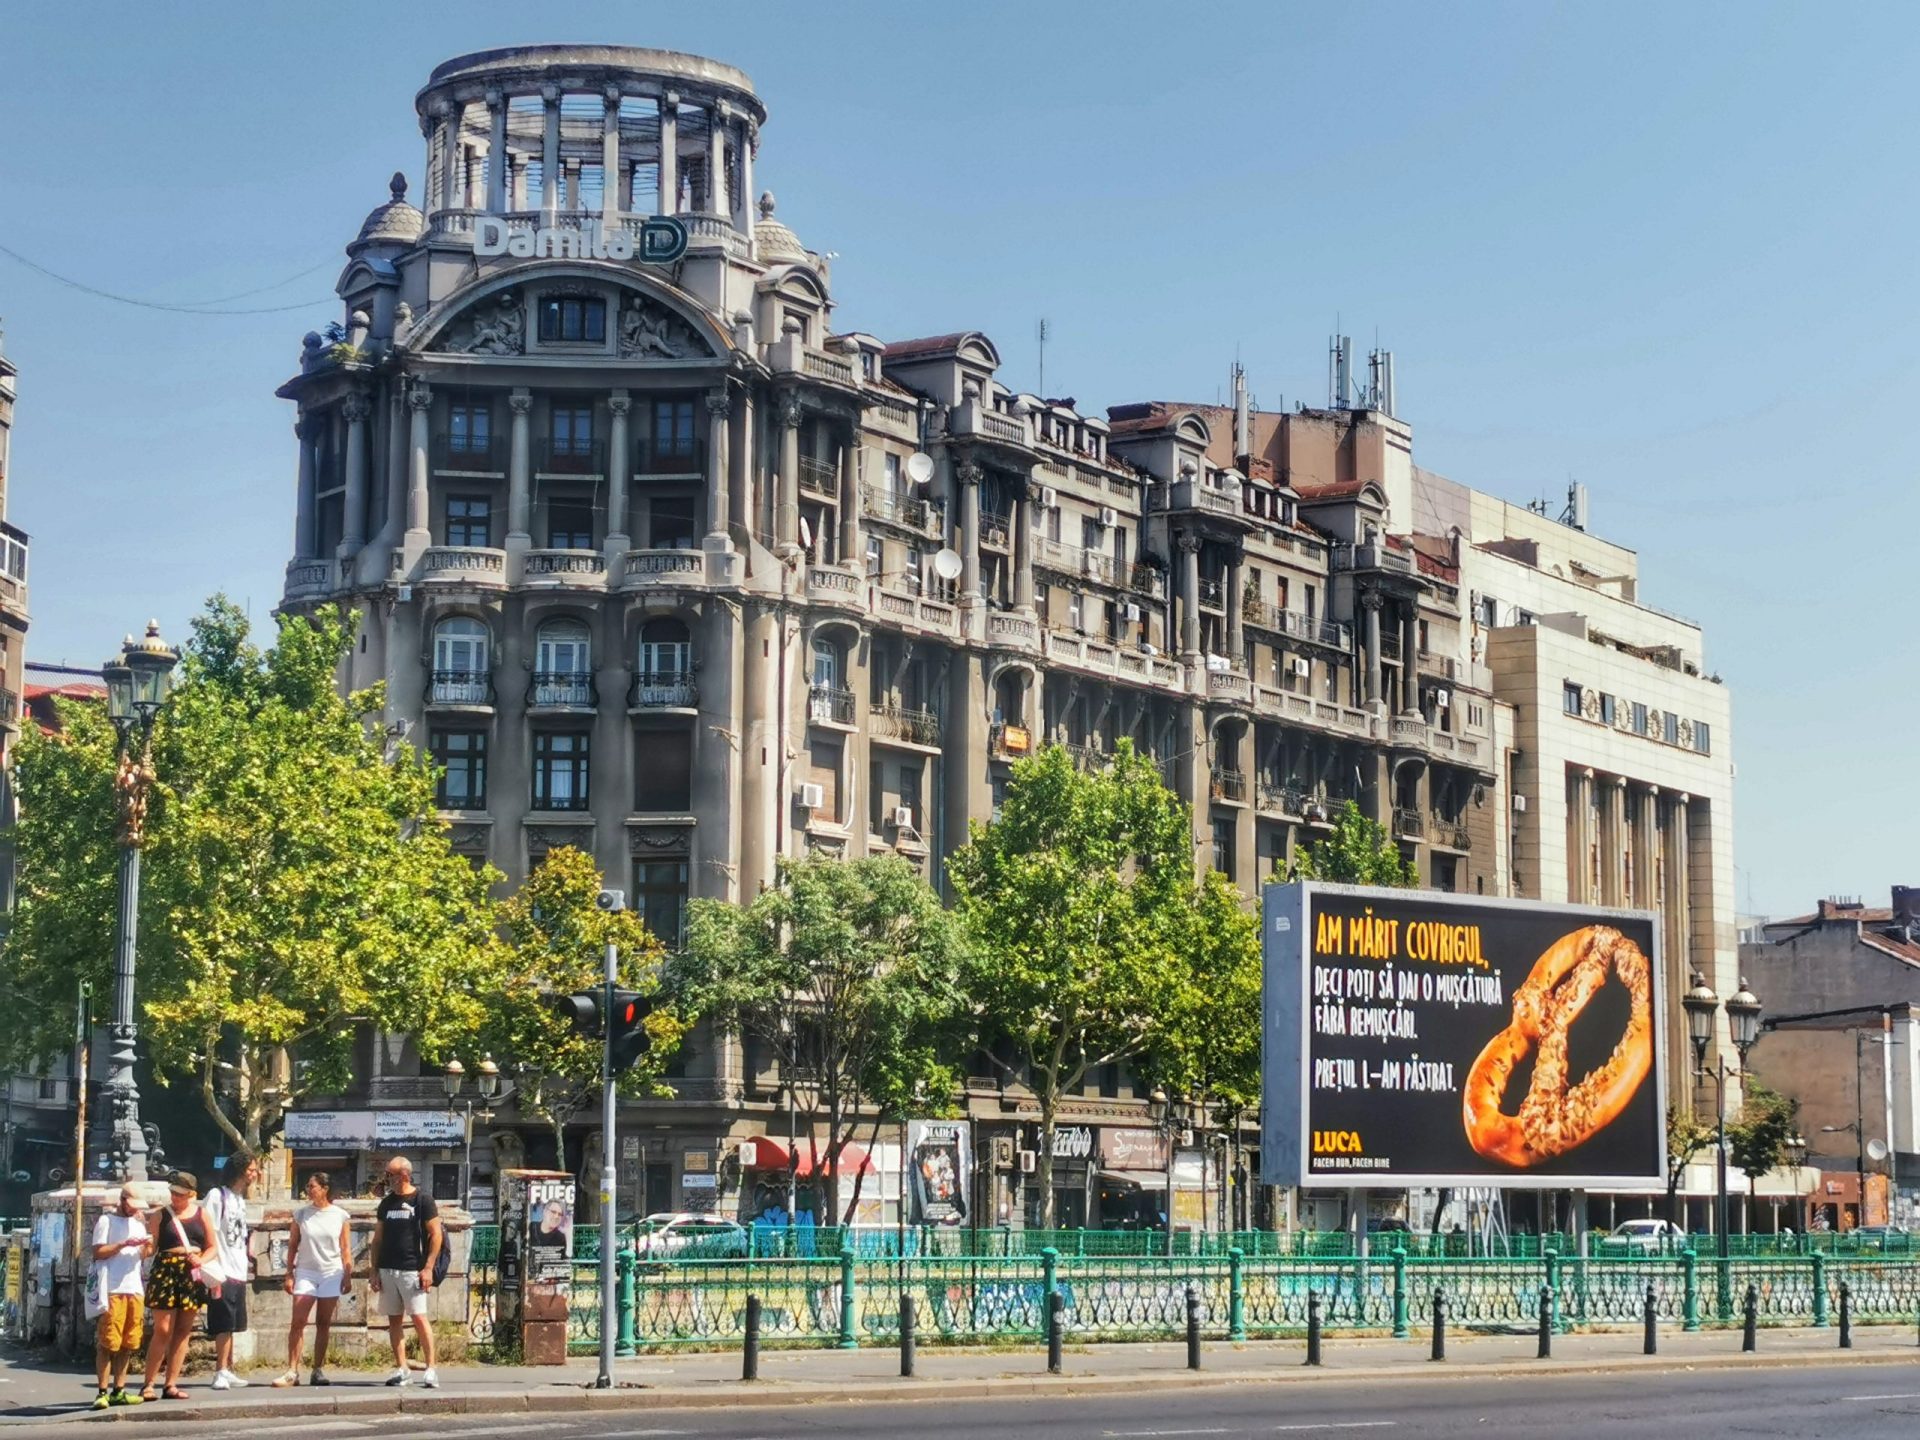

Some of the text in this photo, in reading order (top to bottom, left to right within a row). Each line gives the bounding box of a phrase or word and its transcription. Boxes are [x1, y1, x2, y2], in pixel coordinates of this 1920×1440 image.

[474, 216, 634, 260] Damila
[1316, 906, 1489, 969] AM MĂRIT COVRIGUL,
[1315, 961, 1502, 1010] DECI POȚI SĂ DAI O MUȘCĂTURĂ
[1315, 997, 1418, 1043] FĂRĂ REMUȘCĂRI.
[1315, 1058, 1357, 1092] PREȚUL
[1404, 1053, 1457, 1092] PĂSTRAT.
[1313, 1131, 1362, 1152] LUCA
[272, 1239, 281, 1270] FUEGO
